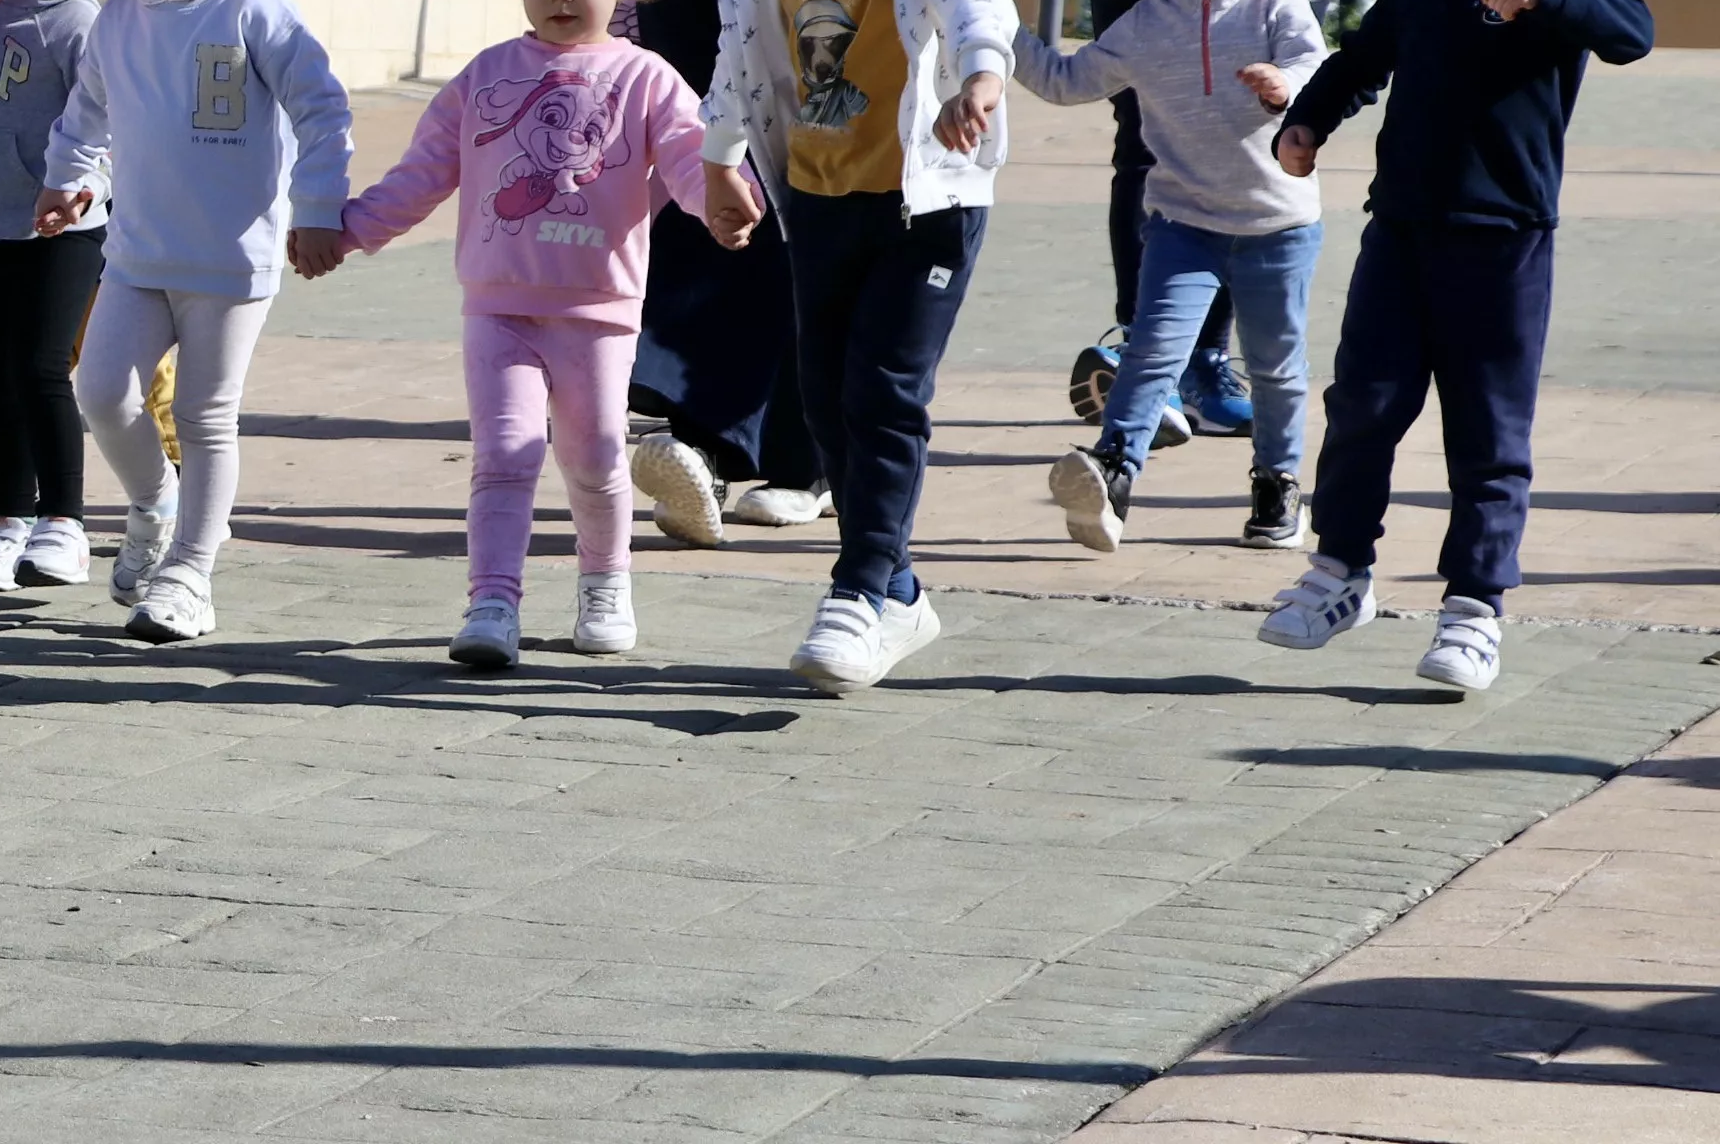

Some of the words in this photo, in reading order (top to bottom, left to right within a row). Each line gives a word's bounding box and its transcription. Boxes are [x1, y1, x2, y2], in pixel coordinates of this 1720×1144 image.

[192, 43, 247, 130] B
[203, 136, 219, 144] FOR
[536, 221, 606, 248] SKYE
